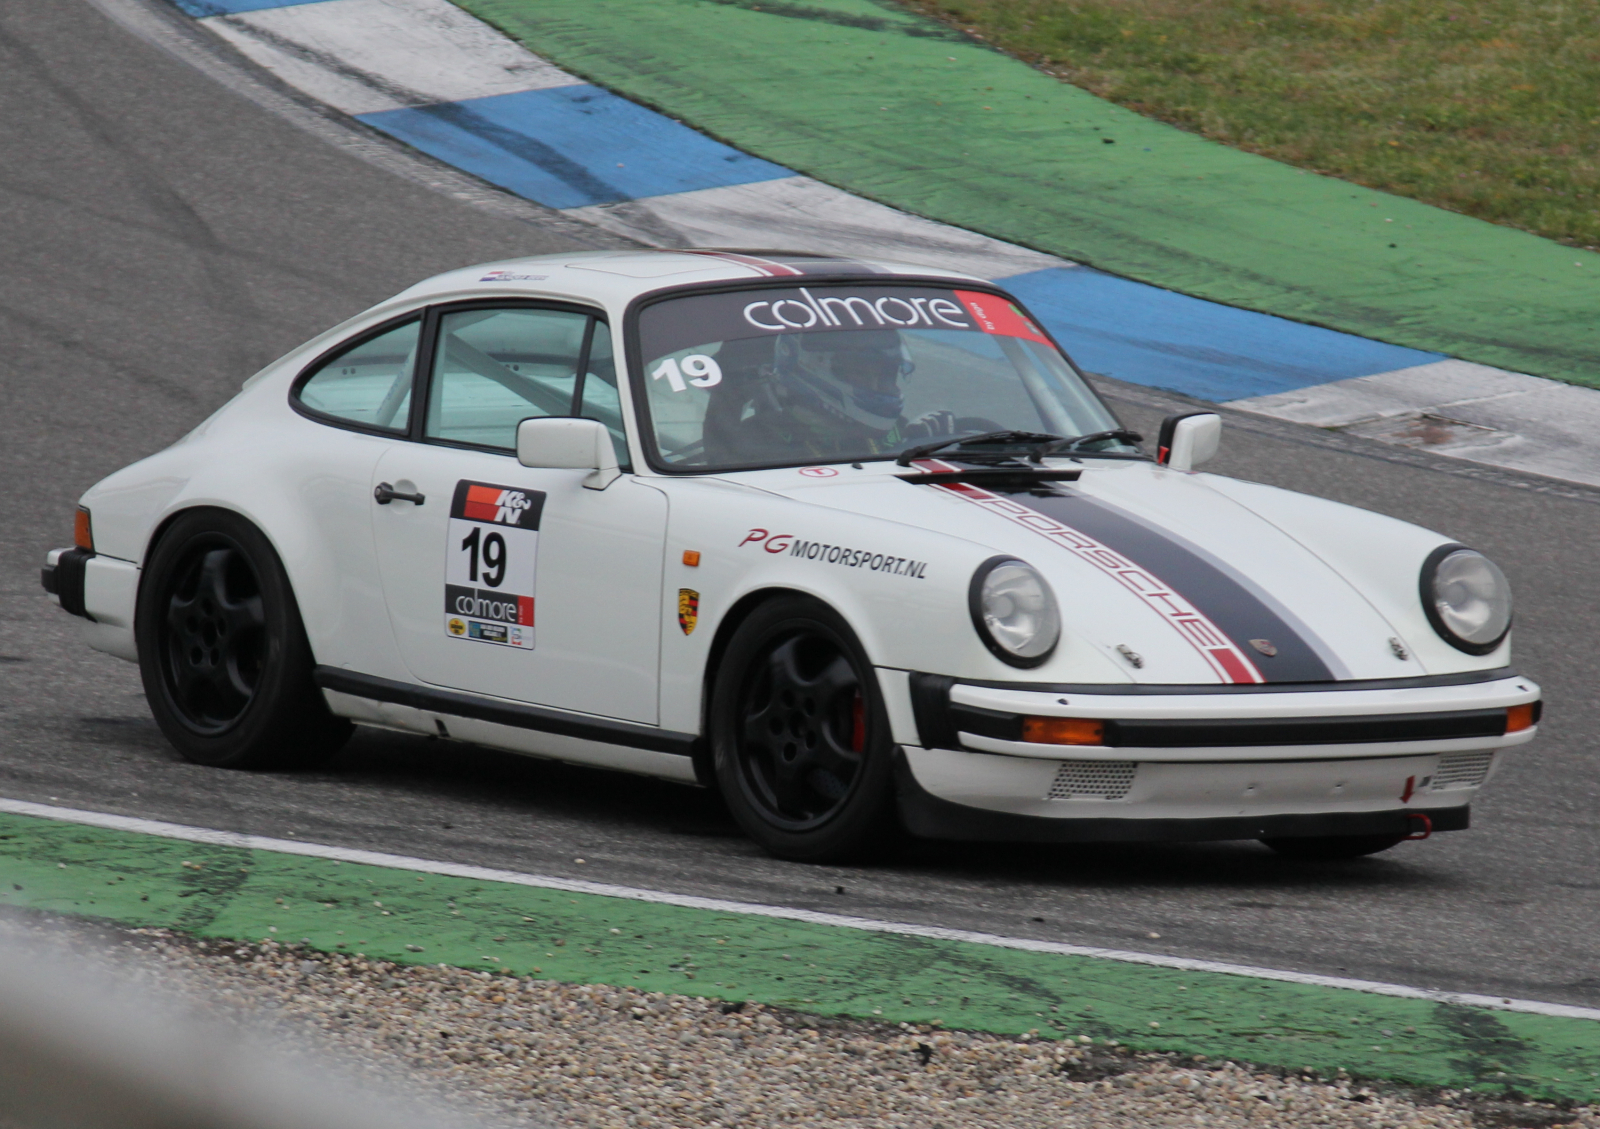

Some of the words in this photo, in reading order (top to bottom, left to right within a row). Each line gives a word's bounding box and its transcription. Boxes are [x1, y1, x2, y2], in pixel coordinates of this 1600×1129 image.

[743, 287, 970, 330] colmore
[651, 354, 723, 392] 19
[493, 506, 522, 525] N
[461, 526, 507, 588] 19
[737, 528, 793, 553] PG
[789, 539, 928, 580] MOTORSPORT.NL
[980, 498, 1228, 650] PORSCHE
[455, 588, 517, 622] colmore
